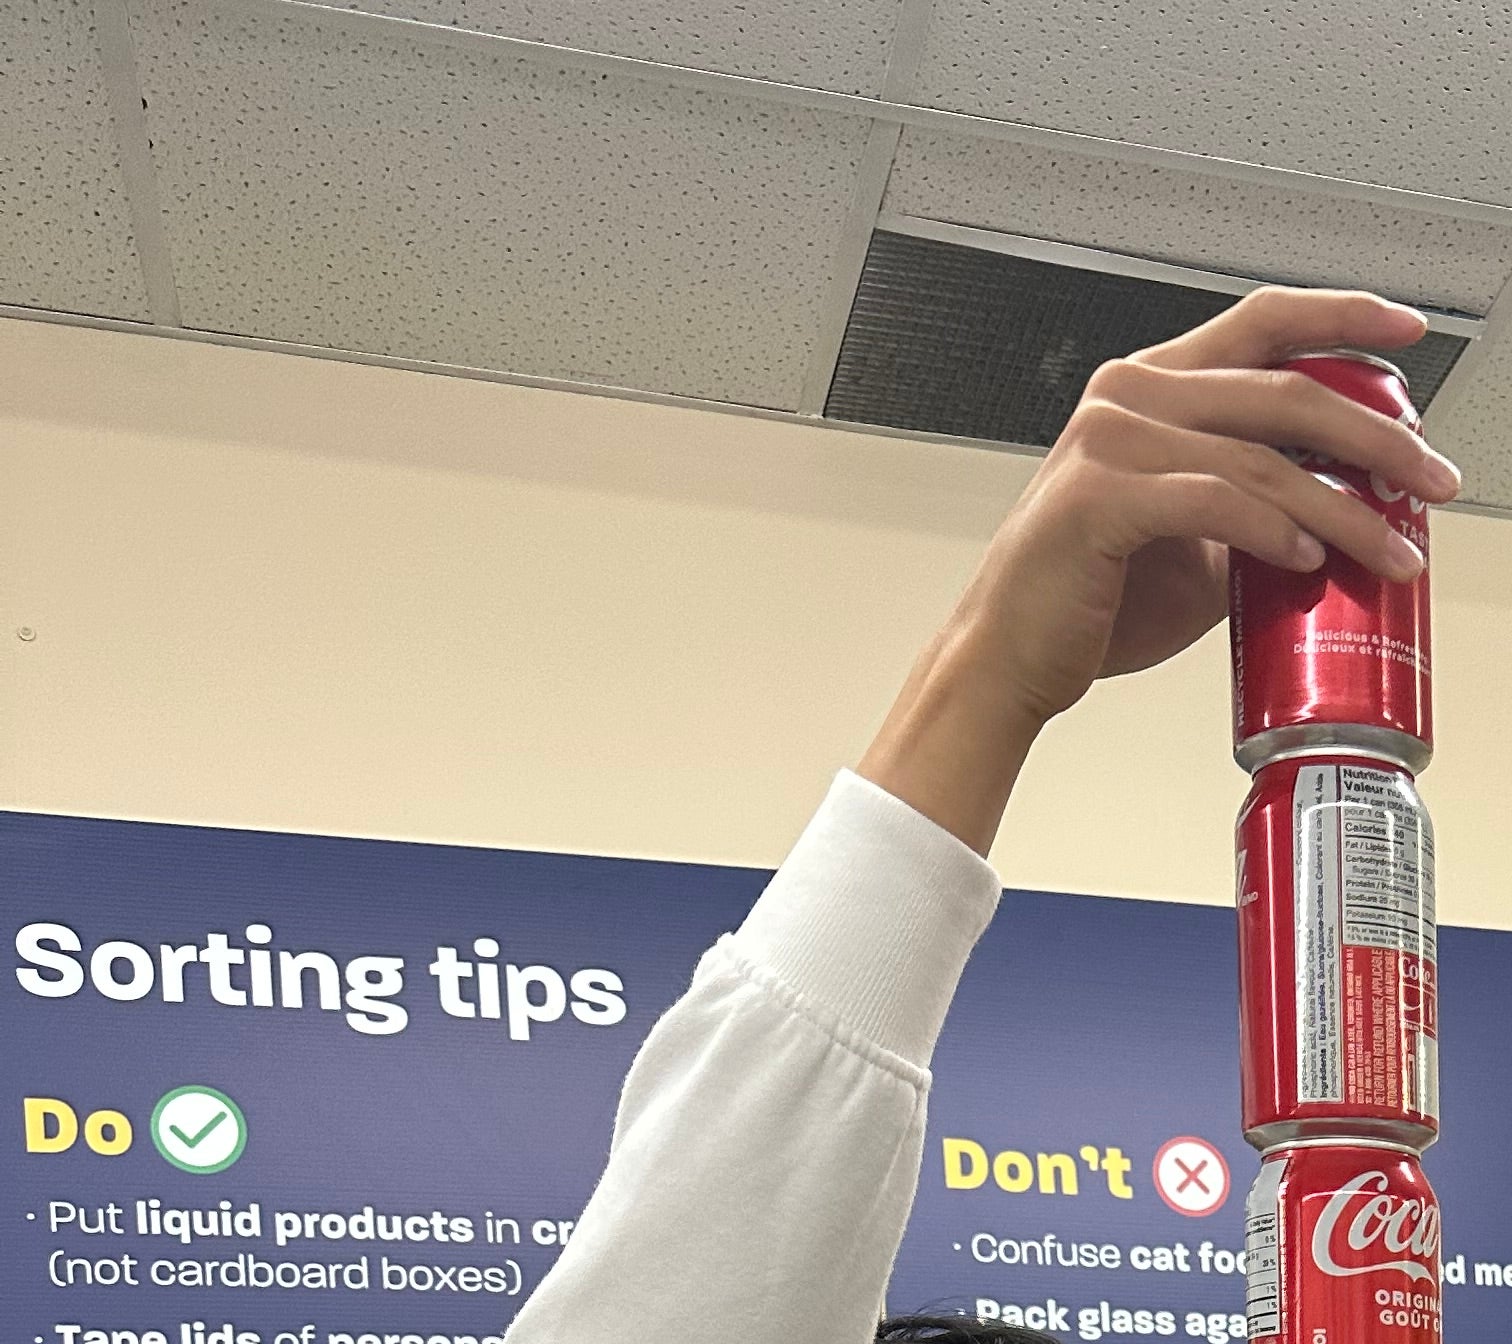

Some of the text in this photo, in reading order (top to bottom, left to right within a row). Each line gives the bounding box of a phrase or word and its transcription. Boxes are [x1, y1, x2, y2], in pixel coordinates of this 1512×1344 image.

[15, 923, 627, 1041] Sorting tips
[23, 1097, 133, 1156] Do
[943, 1137, 1132, 1199] Don't
[49, 1202, 122, 1235] Put
[137, 1199, 261, 1244] liquid
[275, 1207, 474, 1246] products
[485, 1212, 520, 1244] in
[49, 1251, 523, 1296] (not cardboard boxes)
[972, 1233, 1121, 1268] Confuse
[1130, 1243, 1191, 1273] cat
[976, 1298, 1070, 1331] Pack
[1078, 1301, 1176, 1340] glass
[1379, 1306, 1429, 1331] GOÛT
